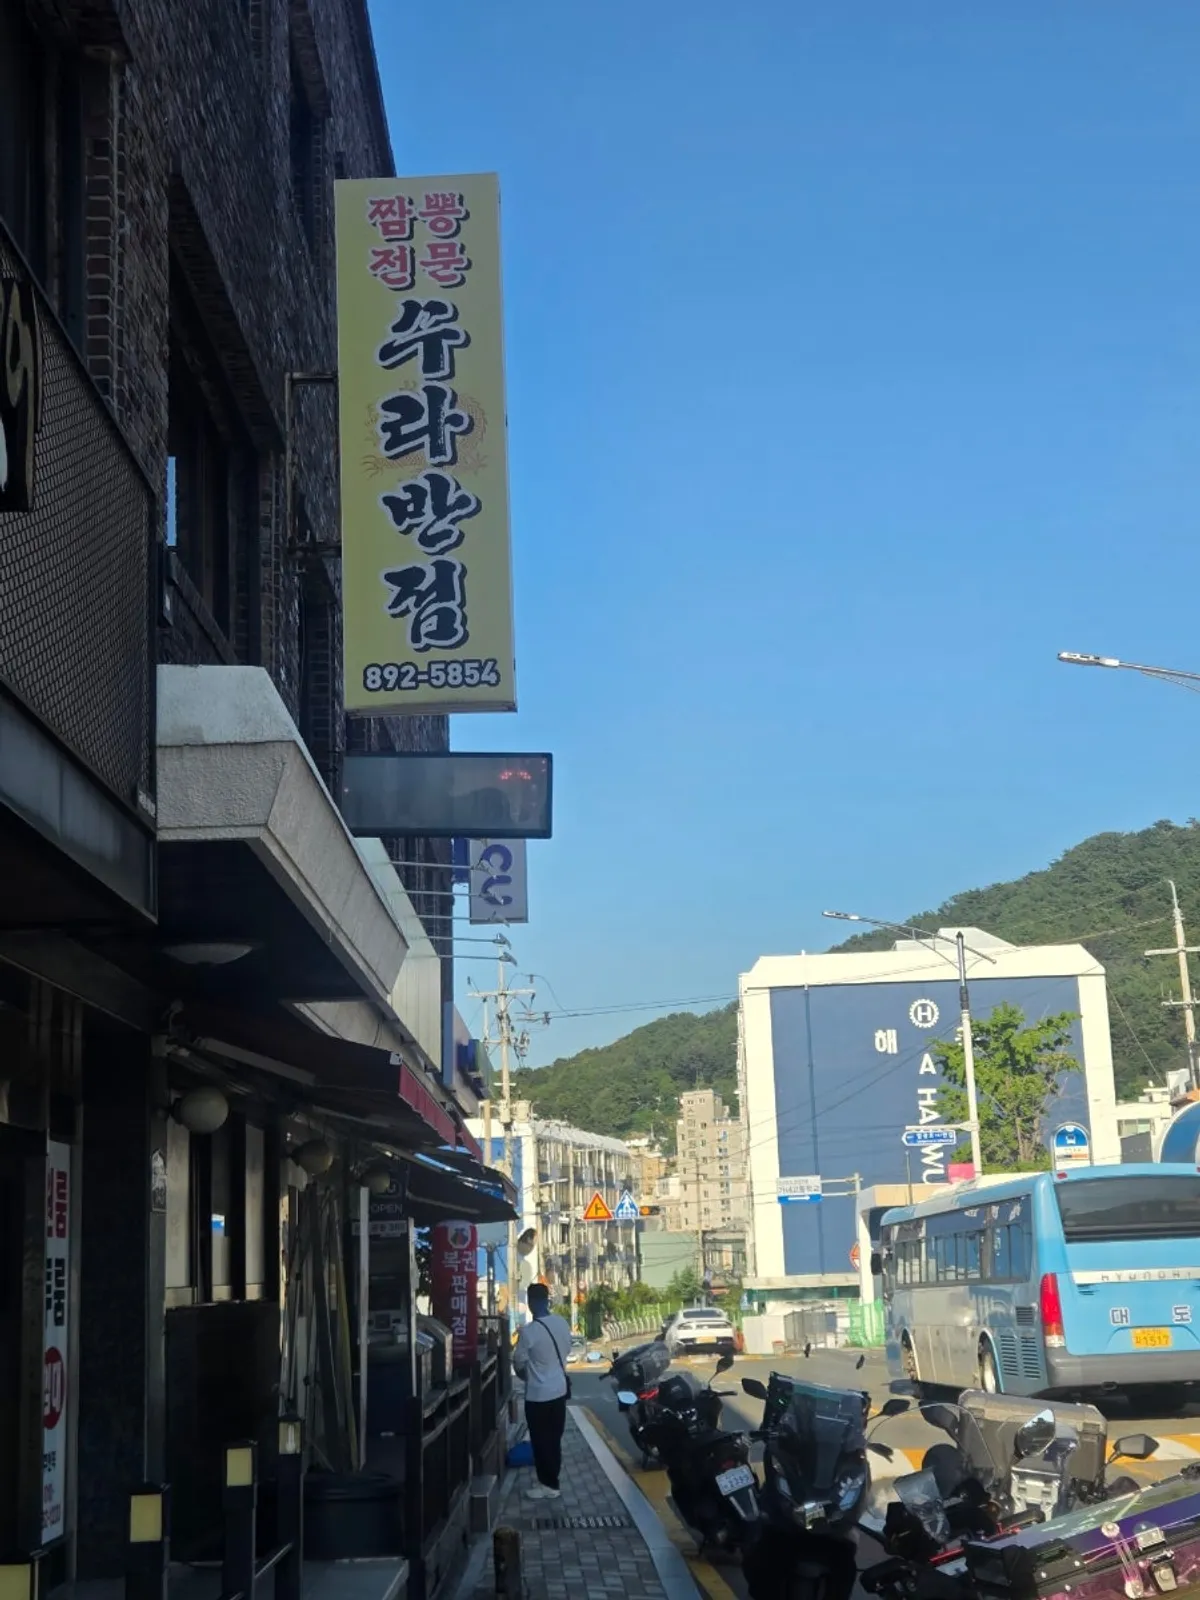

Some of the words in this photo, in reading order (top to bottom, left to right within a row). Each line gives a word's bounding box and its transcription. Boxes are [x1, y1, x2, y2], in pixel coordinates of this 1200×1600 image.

[367, 192, 469, 240] 짬뽕
[368, 241, 471, 289] 전문
[375, 299, 481, 650] 수라반점
[363, 659, 500, 692] 892-5854
[874, 1028, 898, 1055] 해
[370, 1203, 403, 1214] OPEN
[441, 1250, 477, 1273] 복권
[1101, 1269, 1192, 1282] HYUNDAI
[450, 1274, 469, 1337] 판매점
